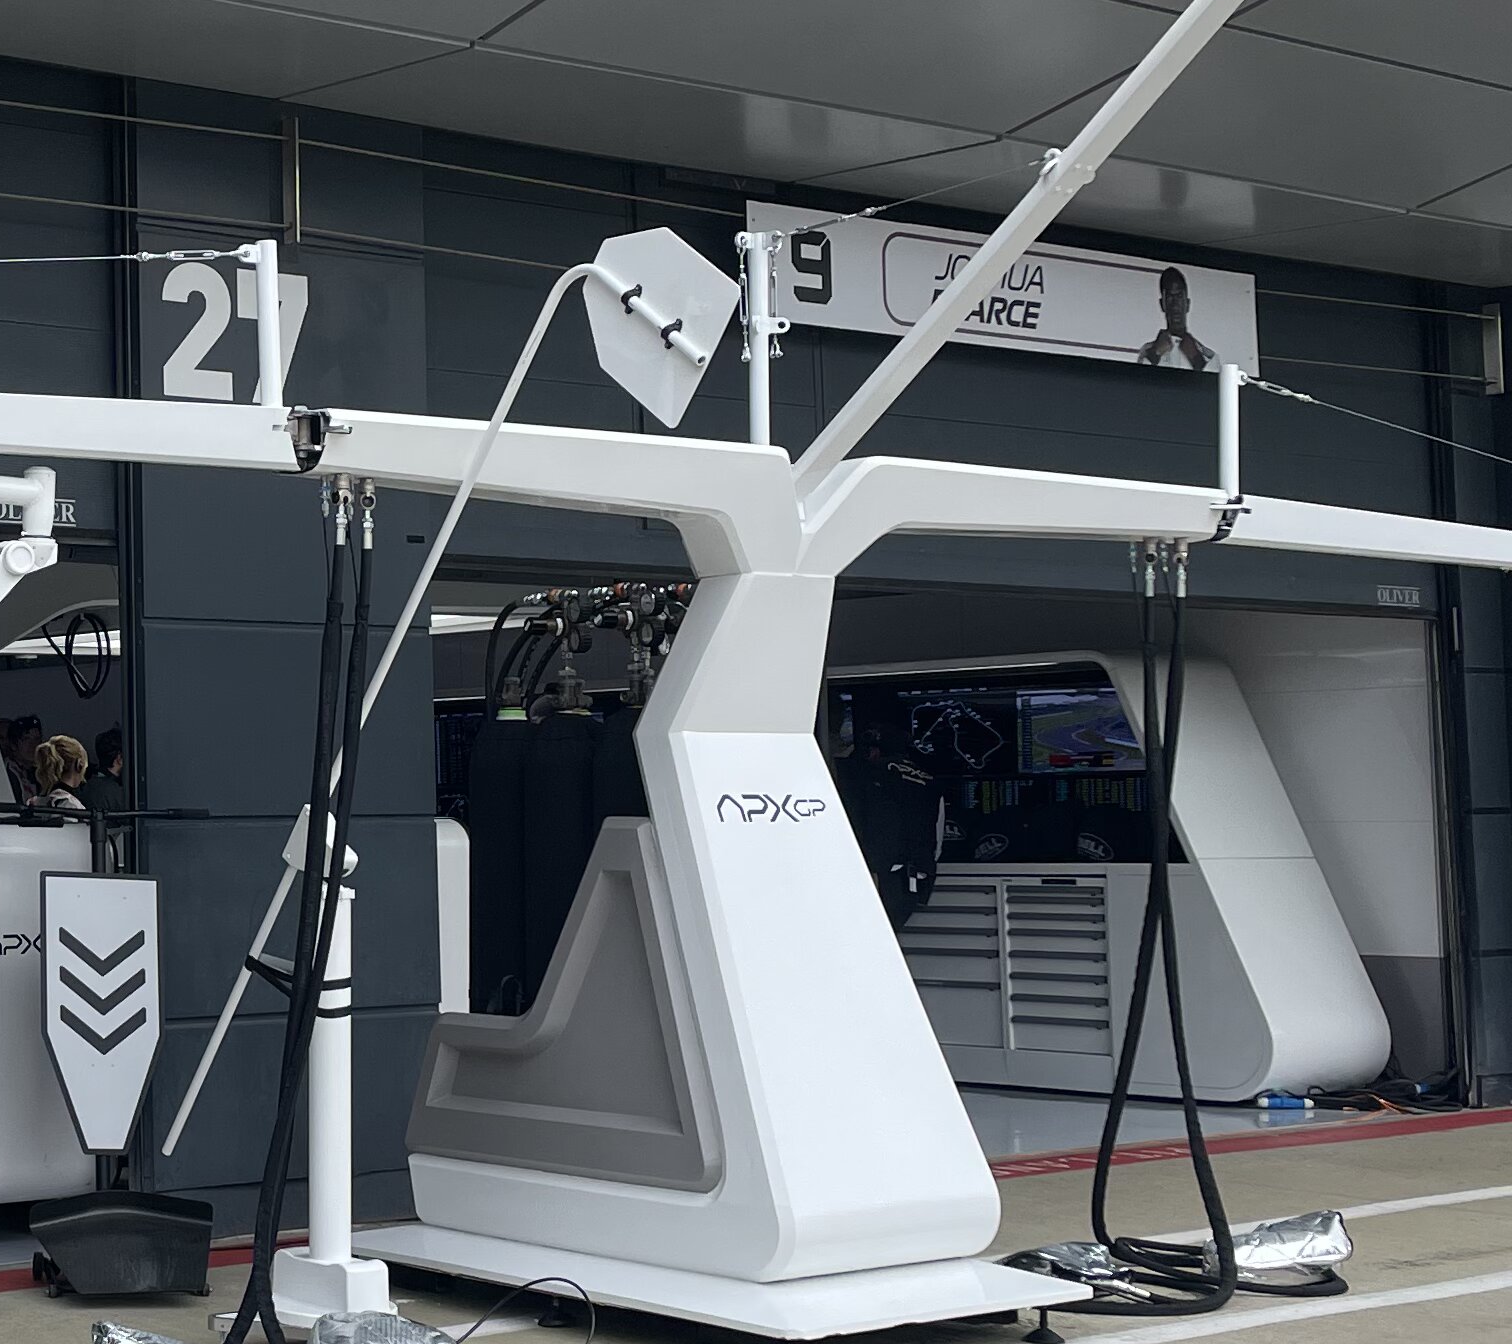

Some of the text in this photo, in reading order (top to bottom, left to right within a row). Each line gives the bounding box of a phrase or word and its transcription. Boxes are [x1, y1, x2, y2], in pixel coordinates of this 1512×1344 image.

[791, 231, 832, 304] 9
[161, 261, 308, 403] 27
[1377, 588, 1420, 604] OLIVER
